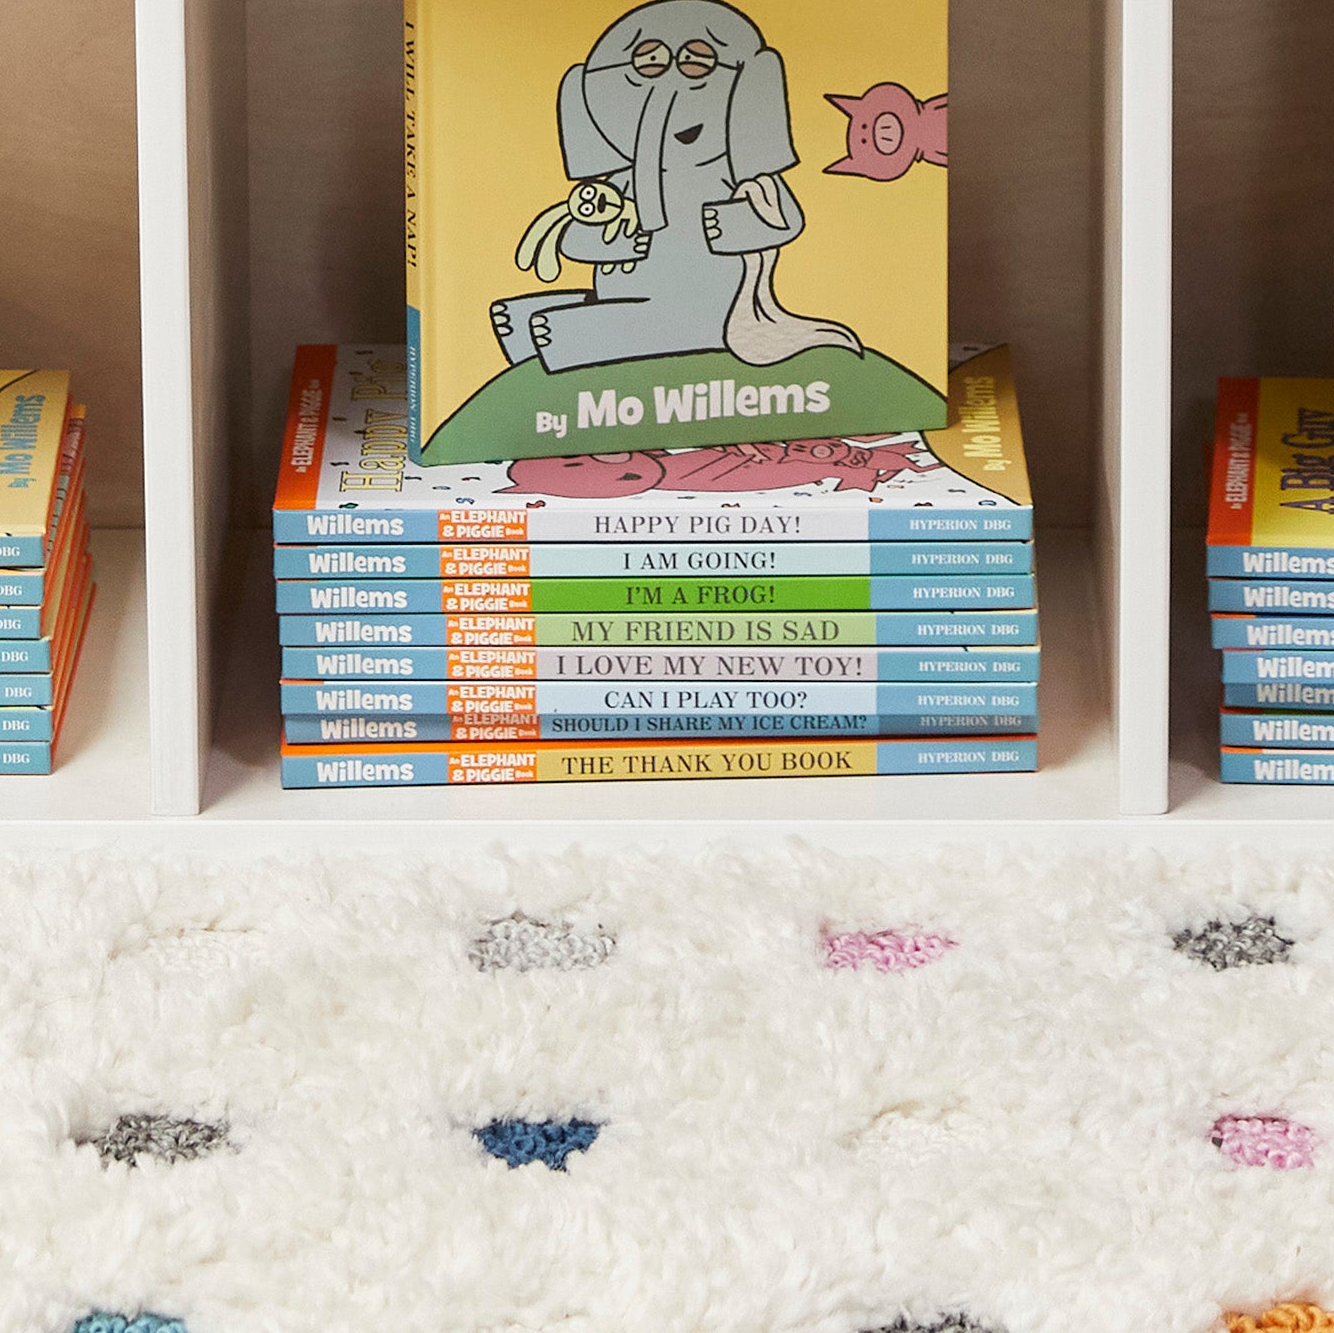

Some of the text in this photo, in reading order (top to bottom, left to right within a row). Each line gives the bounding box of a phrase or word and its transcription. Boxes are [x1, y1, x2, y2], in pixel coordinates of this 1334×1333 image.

[535, 379, 832, 438] By Mo Willems
[306, 513, 405, 536] Willems
[595, 515, 800, 534] HAPPY PIG DAY!
[910, 519, 1012, 531] HYPERION DBG
[624, 551, 775, 570] I AM GOING!
[626, 585, 775, 605] I'M A FROG!
[572, 620, 840, 642] MY FRIEND IS SAD
[557, 655, 862, 677] I LOVE MY NEW TOY!
[604, 690, 808, 709] CAN I PLAY TOO?
[552, 714, 867, 733] SHOULD I SHARE MY ICE CREAM?
[561, 751, 852, 775] THE THANK YOU BOOK
